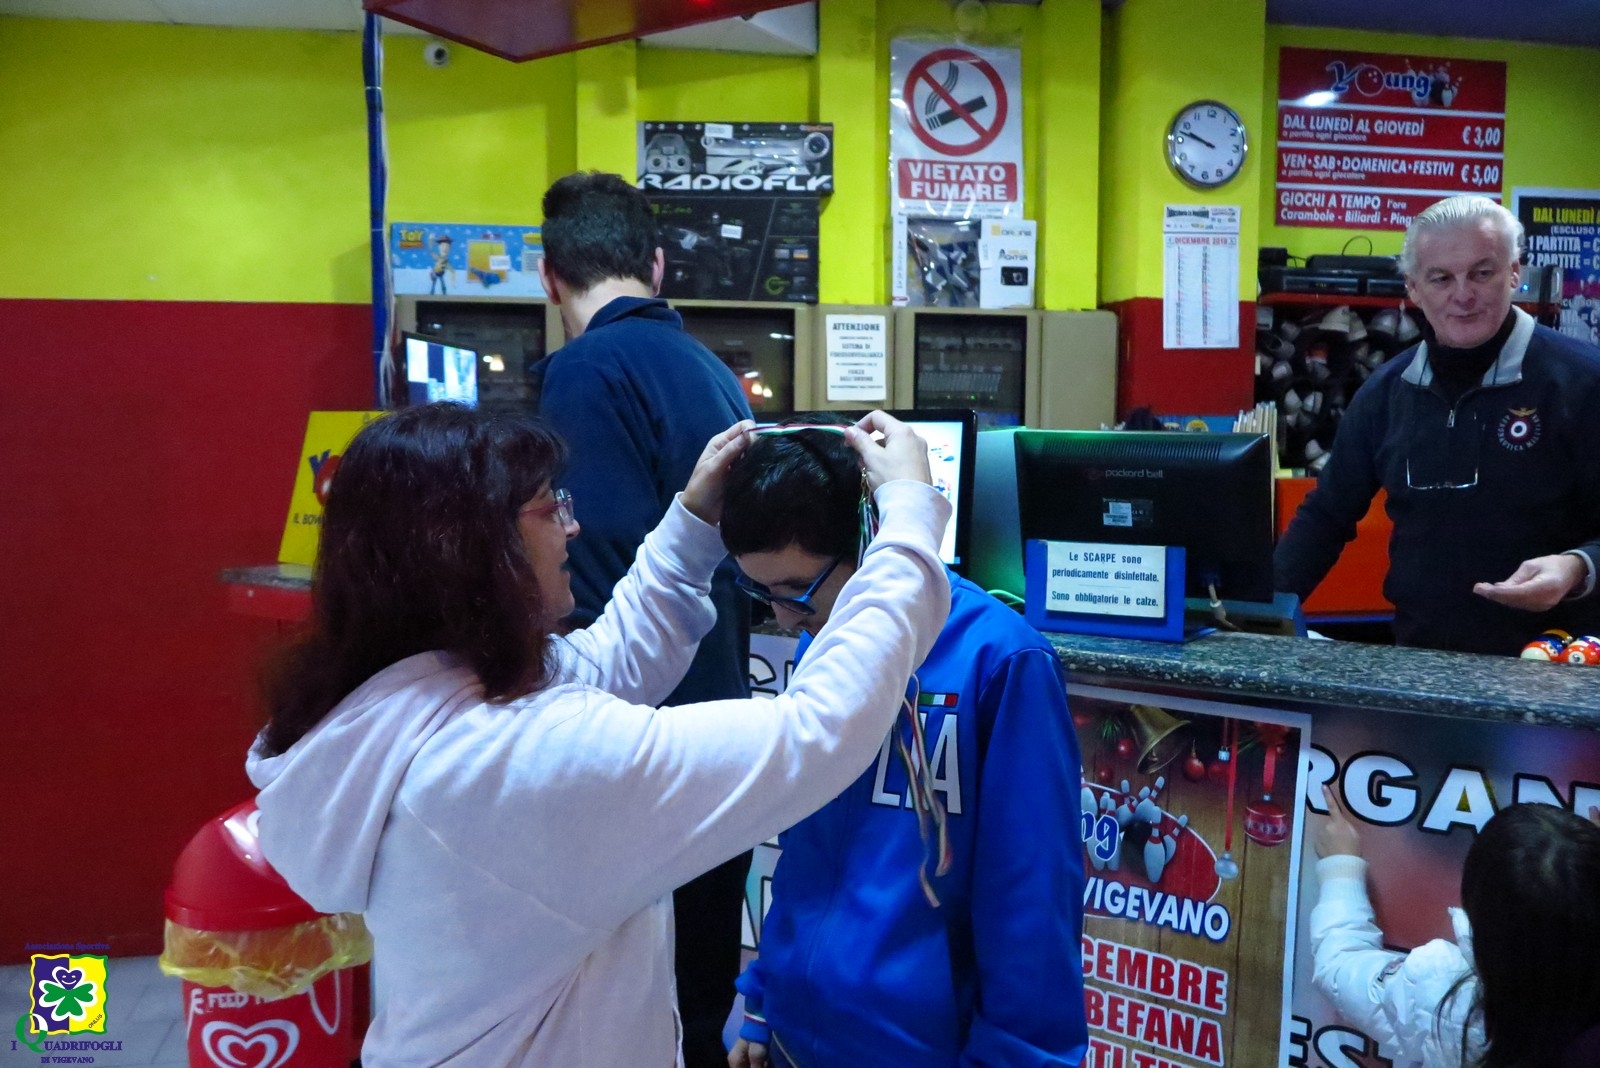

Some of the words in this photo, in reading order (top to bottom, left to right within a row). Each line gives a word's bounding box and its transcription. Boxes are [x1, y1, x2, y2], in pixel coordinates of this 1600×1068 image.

[1194, 112, 1200, 120] 11
[1207, 109, 1217, 118] 12
[1283, 114, 1306, 129] DAL
[1309, 113, 1354, 132] LUNEDÌ
[1356, 119, 1371, 133] AL
[1374, 118, 1425, 136] GIOVEDÌ
[1463, 126, 1471, 145] €
[1474, 126, 1501, 148] 3,00
[908, 162, 1006, 182] VIETATO
[1201, 171, 1209, 180] 6
[1461, 164, 1470, 183] €
[1472, 165, 1499, 187] 5,00
[635, 174, 832, 192] RADIOFLY
[911, 181, 1007, 200] FUMARE
[1281, 191, 1326, 207] GIOCHI
[1328, 193, 1337, 208] A
[1341, 194, 1381, 209] TEMPO
[1281, 208, 1335, 222] Carambole
[1345, 210, 1381, 224] Biliardi
[1533, 207, 1553, 222] DAL
[1556, 207, 1594, 224] LUNEDÌ
[1528, 236, 1534, 250] 1
[1536, 236, 1580, 252] PARTITA
[1527, 253, 1534, 267] 2
[1537, 253, 1581, 269] PARTITE
[832, 323, 880, 331] ATTENZIONE
[1105, 469, 1144, 478] packard
[1146, 469, 1163, 478] bell
[1069, 551, 1079, 562] Le
[1083, 552, 1116, 564] SCARPE
[1122, 555, 1142, 564] sono
[1052, 568, 1109, 580] periodicamente
[1114, 571, 1160, 582] disinfettate.
[1052, 590, 1070, 601] Sono
[1075, 592, 1119, 604] obbligatorie
[1124, 595, 1131, 605] le
[1136, 597, 1159, 607] calze.
[1083, 877, 1230, 941] VIGEVANO
[1081, 935, 1227, 1013] CEMBRE
[208, 992, 249, 1008] FEED
[1084, 985, 1223, 1065] BEFANA
